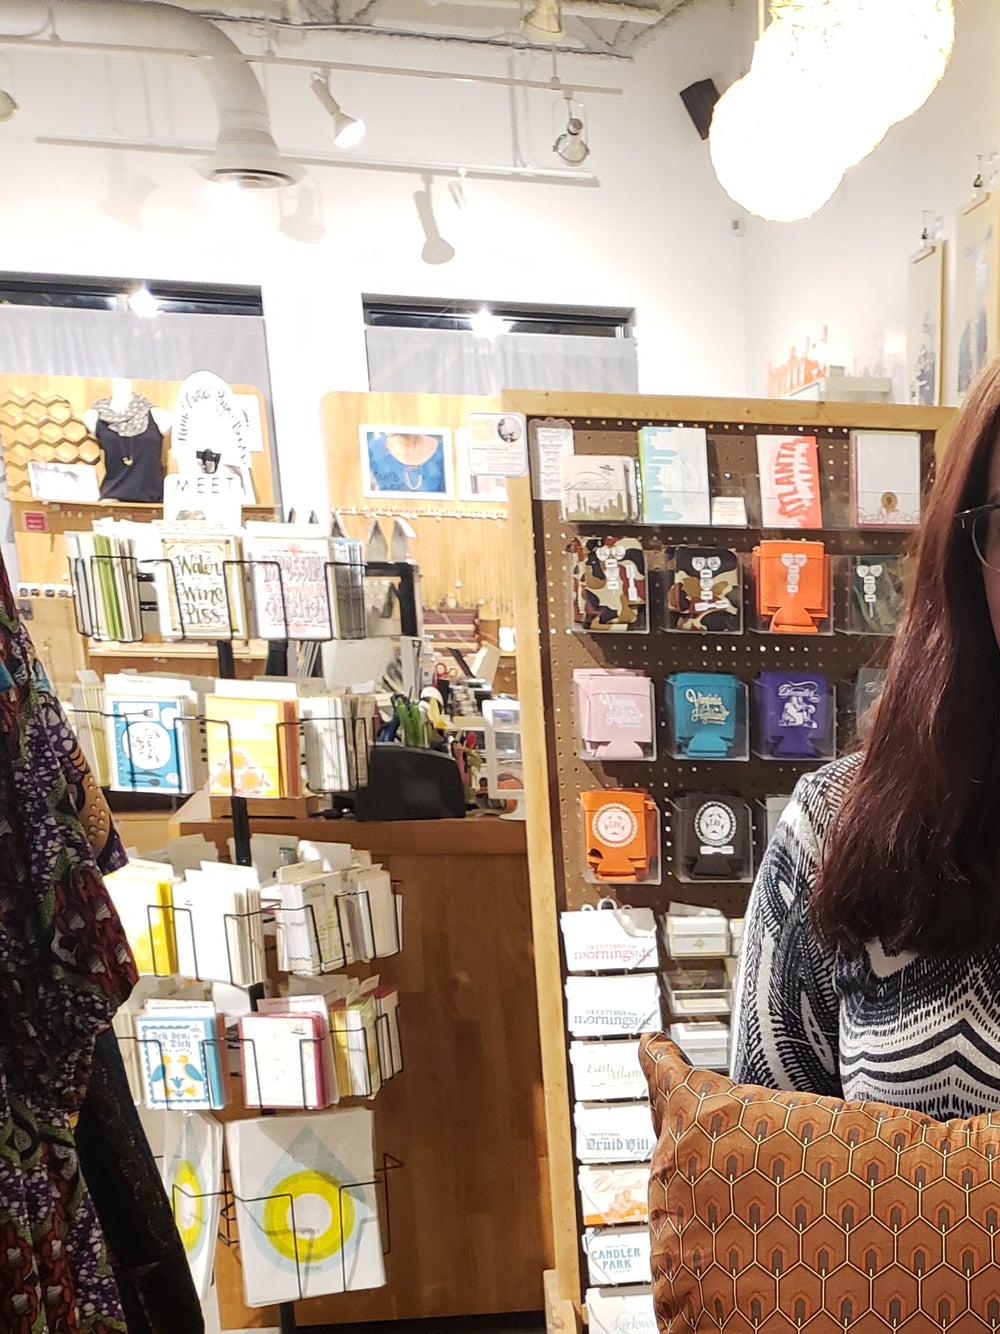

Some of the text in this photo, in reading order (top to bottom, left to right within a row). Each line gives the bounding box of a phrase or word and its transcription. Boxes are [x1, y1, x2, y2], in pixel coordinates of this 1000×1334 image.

[175, 476, 235, 494] MEET
[177, 582, 224, 603] Wine
[586, 1138, 623, 1151] Druid
[591, 1248, 642, 1260] CANDLER
[602, 1259, 633, 1271] PARK
